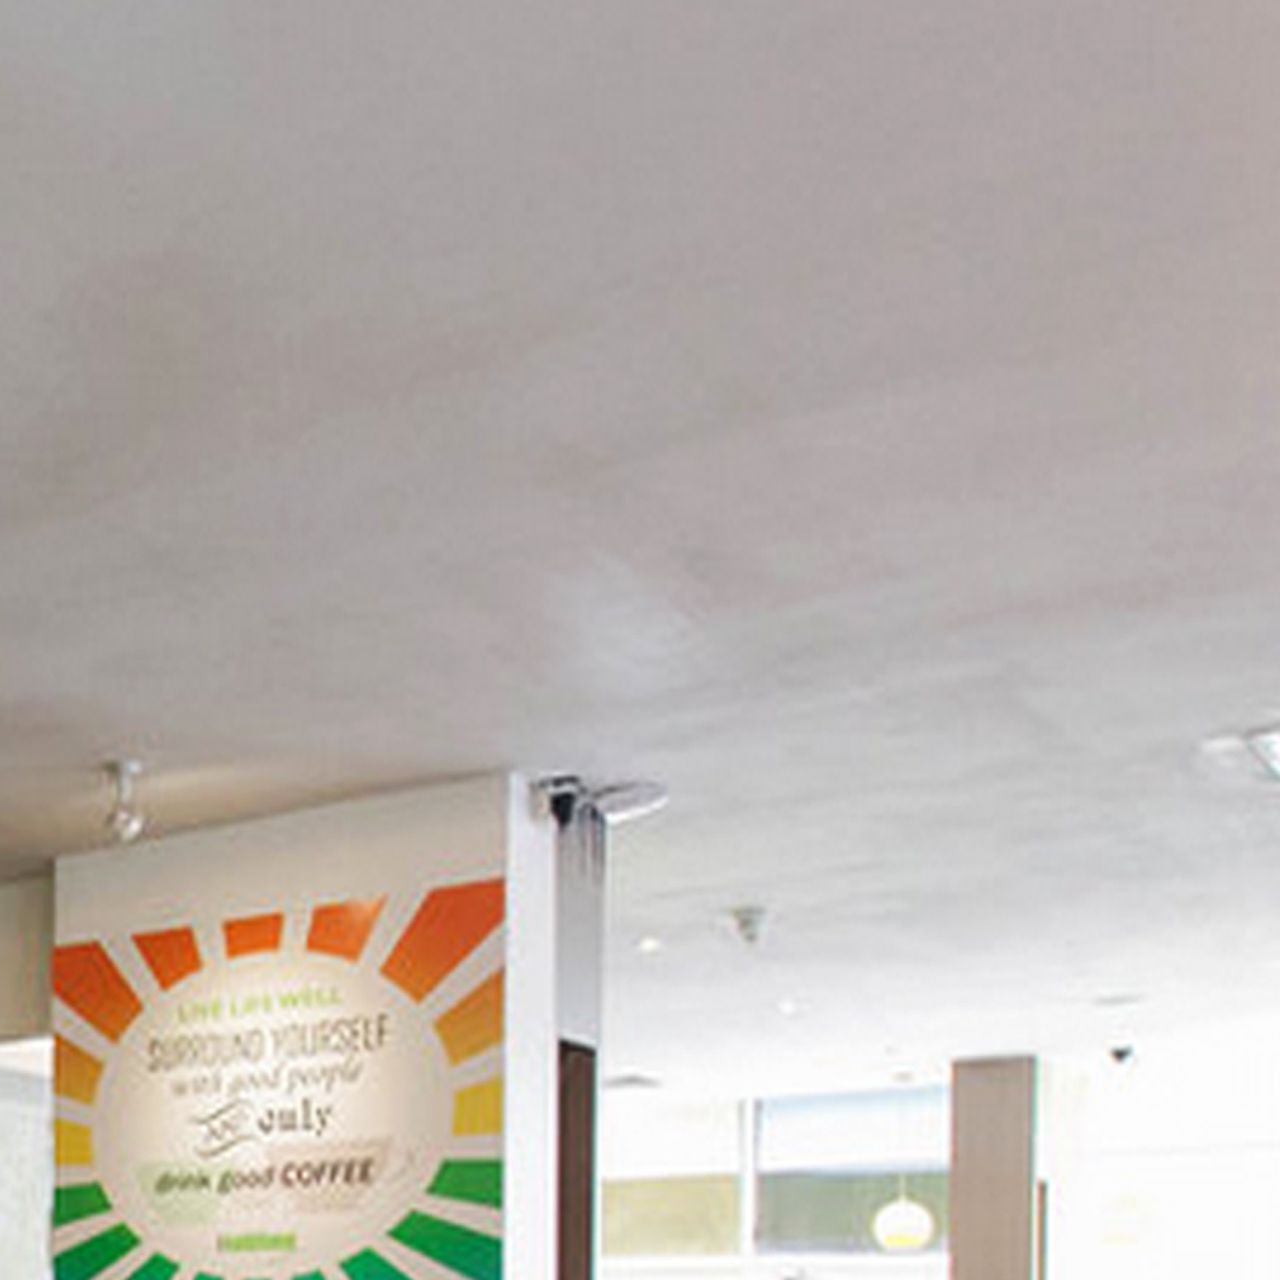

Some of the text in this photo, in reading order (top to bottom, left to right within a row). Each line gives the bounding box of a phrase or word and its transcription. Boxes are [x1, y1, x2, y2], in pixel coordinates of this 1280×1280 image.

[270, 1012, 389, 1058] YOURSELF
[216, 1164, 276, 1195] good
[280, 1157, 376, 1188] COFFEE
